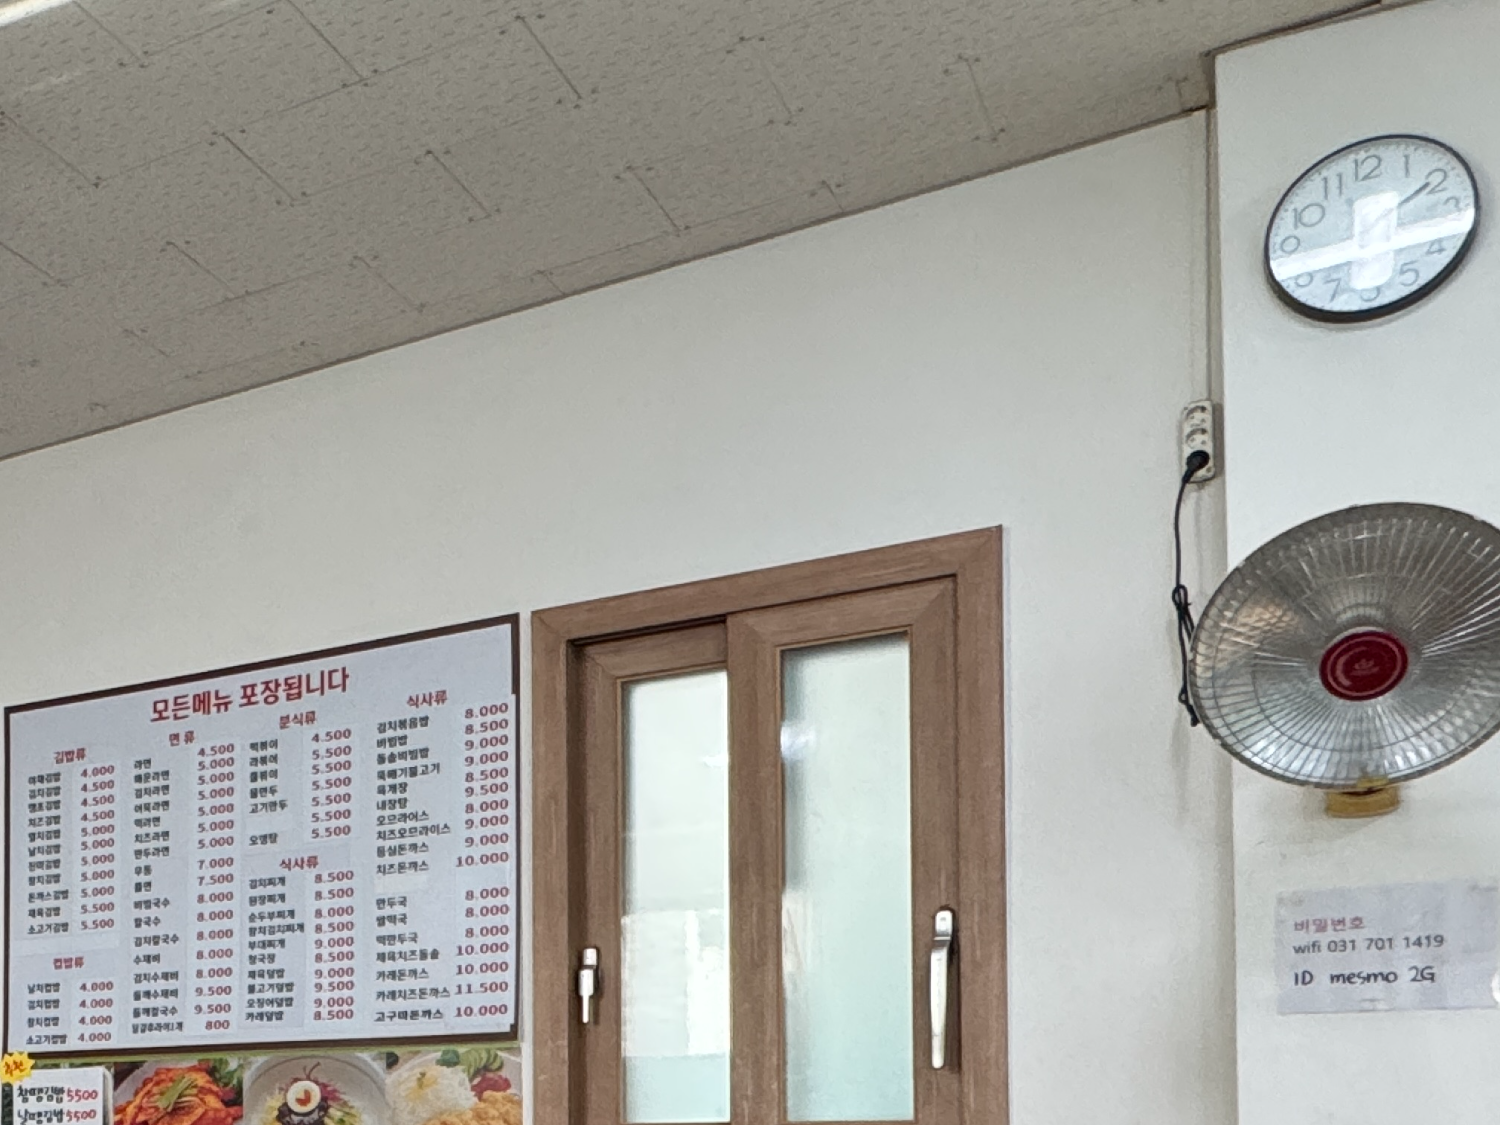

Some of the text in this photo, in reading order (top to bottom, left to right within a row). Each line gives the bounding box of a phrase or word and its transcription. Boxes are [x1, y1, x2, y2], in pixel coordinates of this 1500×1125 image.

[1354, 155, 1383, 182] 12
[1403, 154, 1411, 178] 1
[1322, 172, 1343, 200] 11
[1425, 168, 1448, 195] 2
[1293, 202, 1326, 230] 10
[1399, 260, 1420, 287] 5
[1323, 278, 1342, 303] 7
[150, 666, 350, 722] 모든메뉴 포장됩니다
[376, 810, 429, 826] 오므라이스
[376, 822, 450, 841] 치즈오므라이스
[1293, 916, 1365, 933] 비밀번호
[1292, 934, 1445, 954] wifi 031 701 1419
[1294, 965, 1436, 985] ID mesmo 2G
[66, 1087, 99, 1103] 5500
[66, 1109, 97, 1123] 5500
